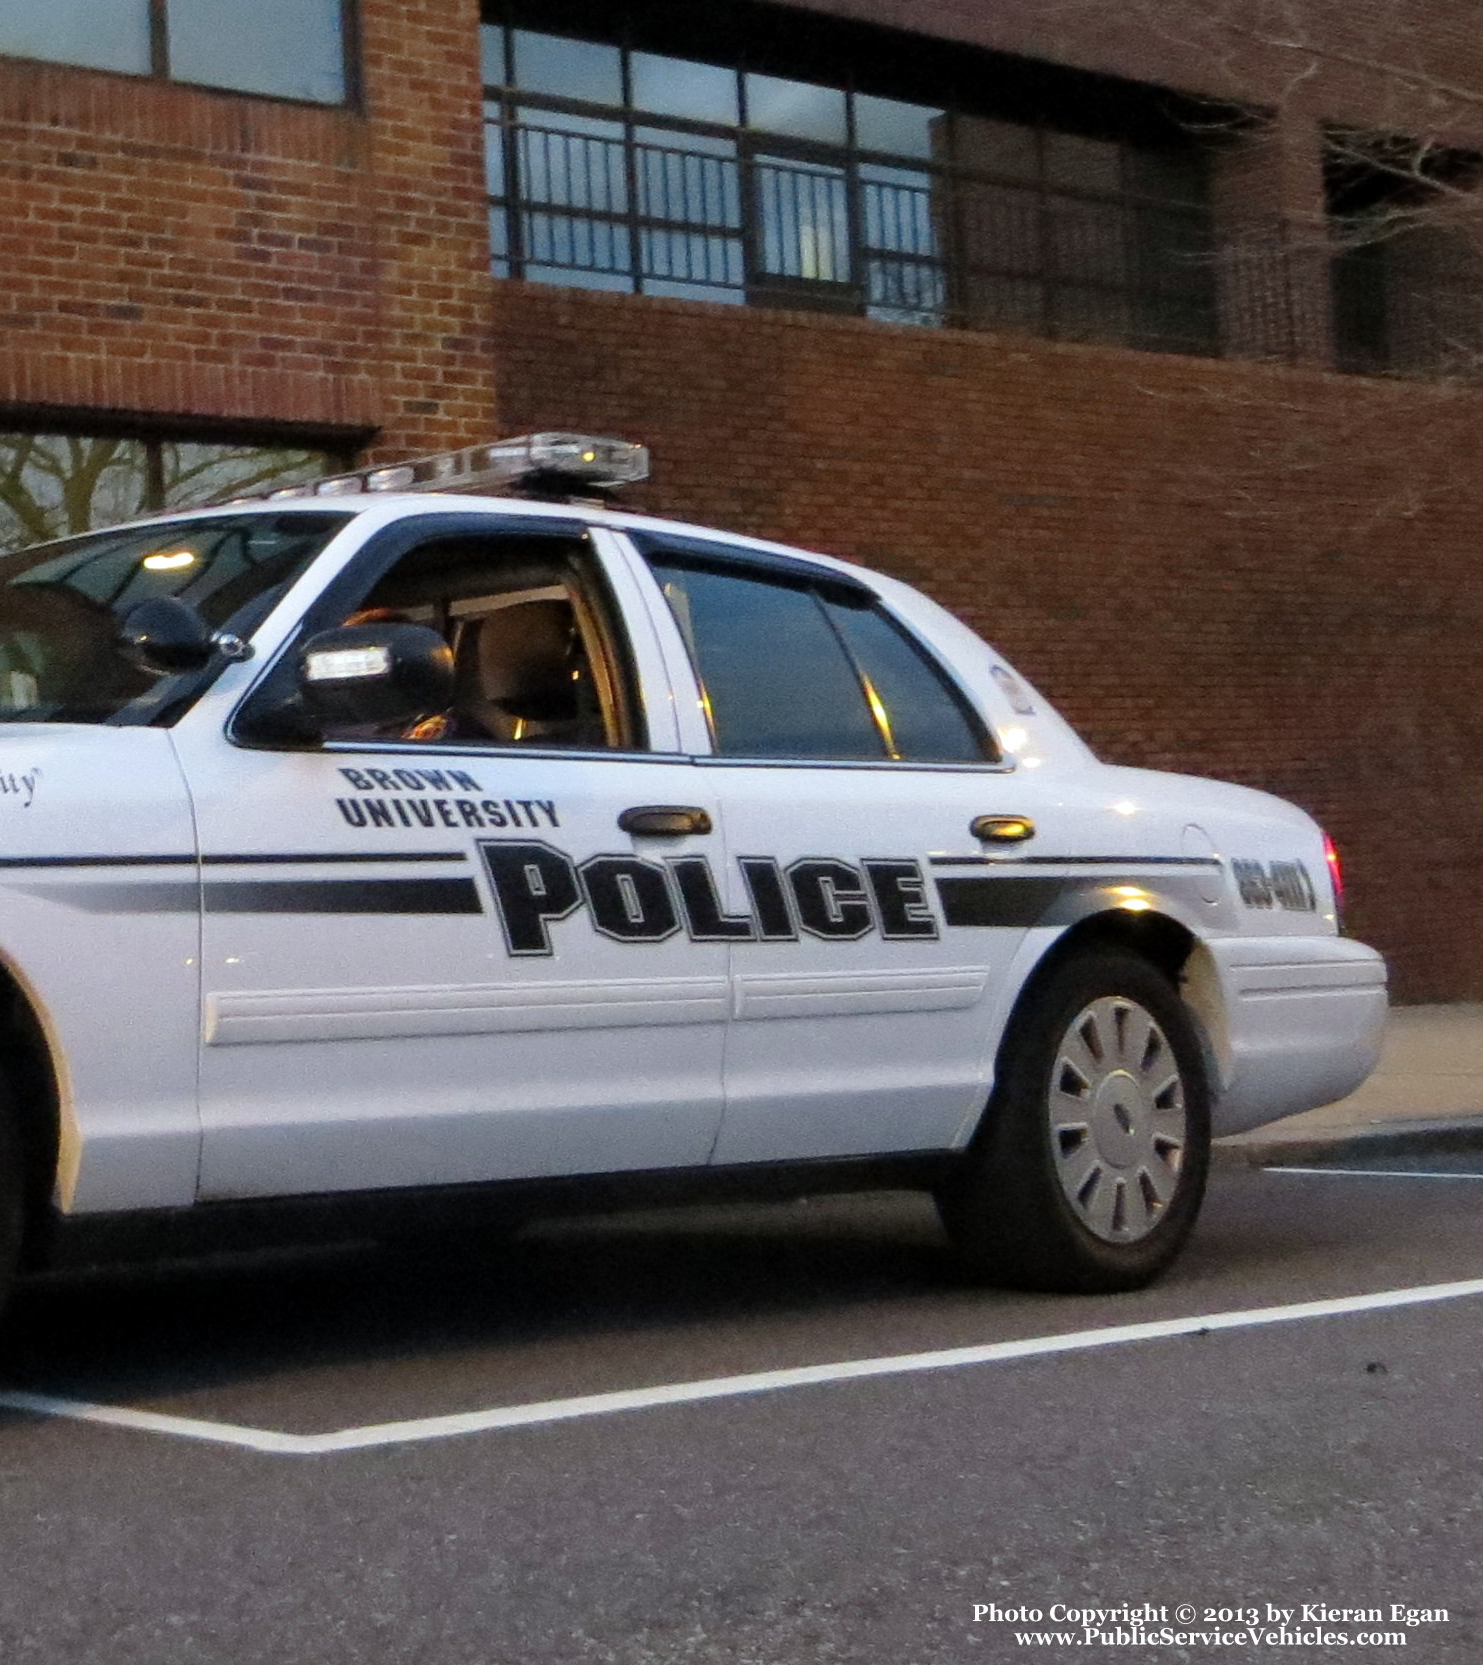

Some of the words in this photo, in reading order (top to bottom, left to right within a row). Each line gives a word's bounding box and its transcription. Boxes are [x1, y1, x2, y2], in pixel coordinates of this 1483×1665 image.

[338, 768, 483, 791] BROWN
[335, 799, 560, 828] UNIVERSITY
[475, 838, 940, 957] POLICE
